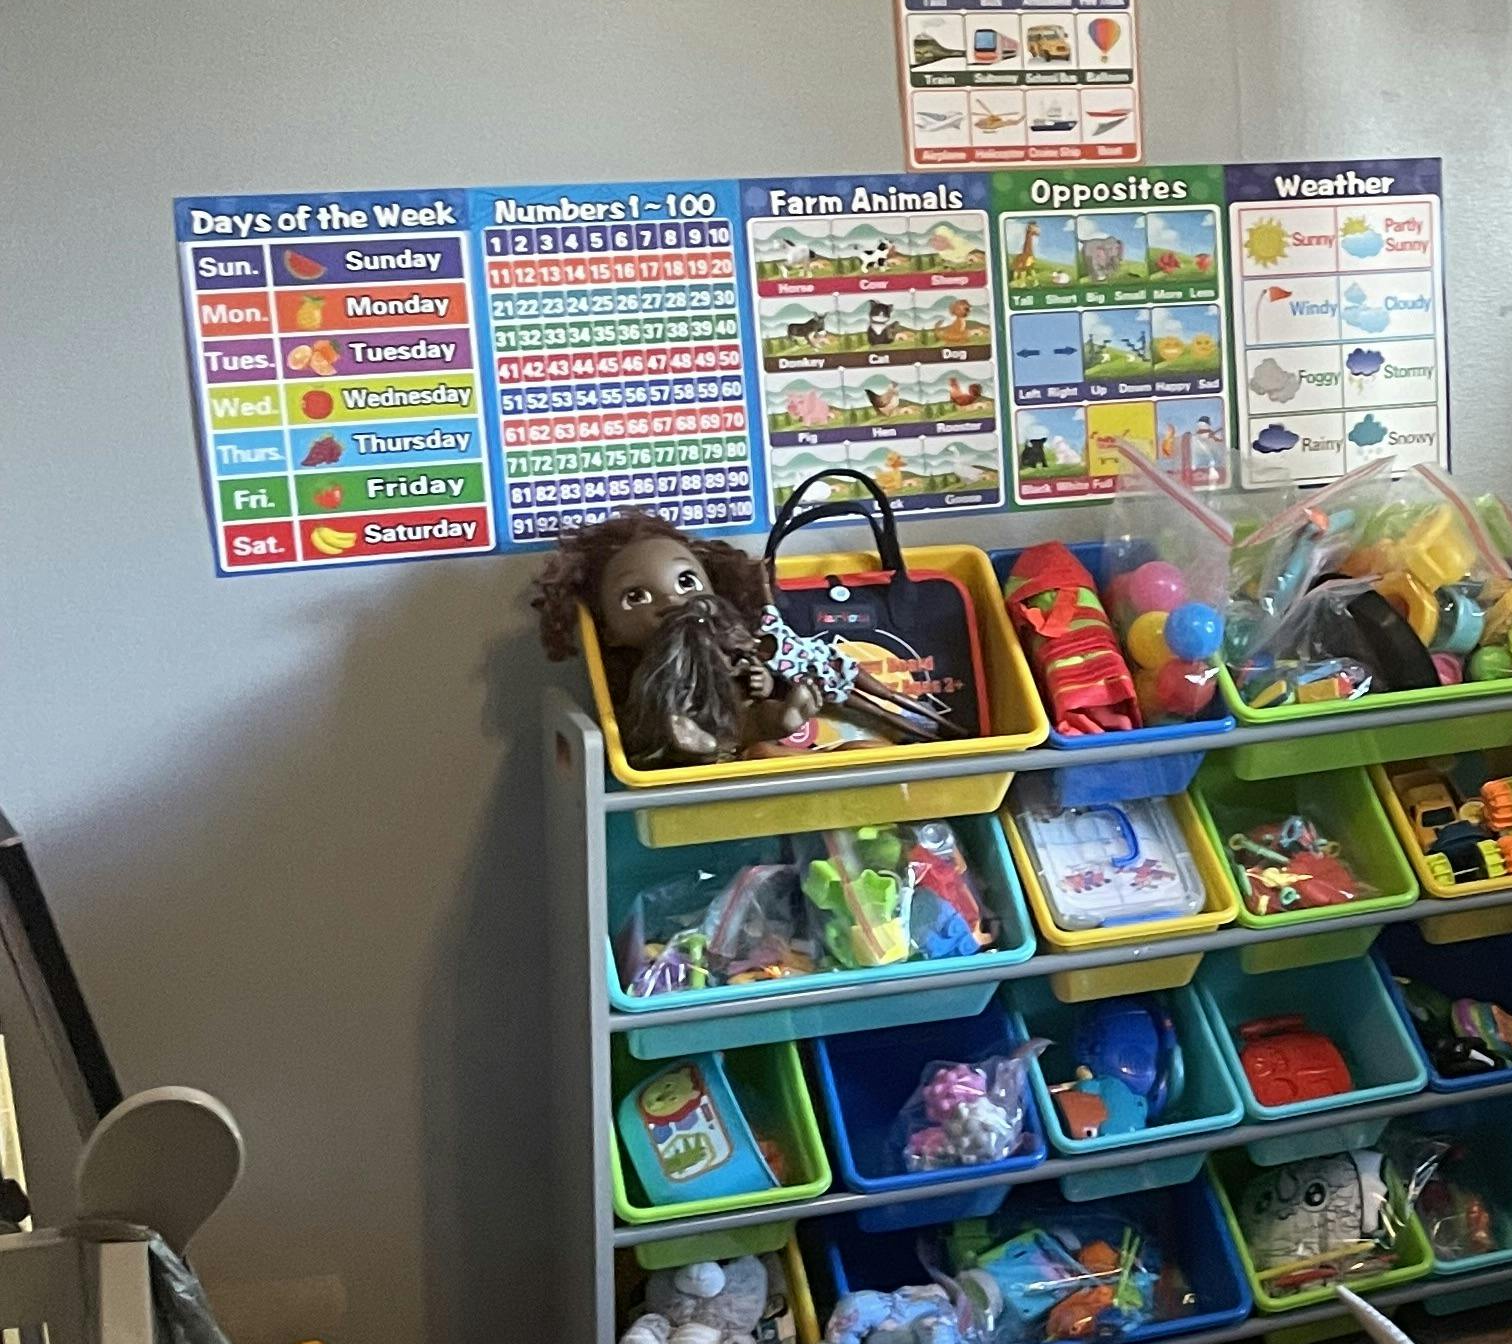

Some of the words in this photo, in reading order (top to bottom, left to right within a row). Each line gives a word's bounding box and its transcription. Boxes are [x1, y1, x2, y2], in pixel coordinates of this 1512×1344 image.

[1031, 176, 1188, 208] Opposites
[1275, 170, 1395, 198] Weather
[494, 197, 626, 224] Numbers
[770, 190, 843, 216] Farm
[851, 184, 964, 213] Animals
[191, 210, 272, 238] Days
[278, 205, 312, 231] of
[317, 203, 368, 230] the
[372, 201, 457, 229] Week
[1385, 217, 1424, 234] Partly
[493, 237, 505, 254] 1
[517, 236, 530, 253] 2
[542, 235, 554, 252] 3
[567, 234, 579, 251] 4
[591, 233, 603, 250] 5
[615, 232, 627, 249] 6
[640, 231, 651, 248] 7
[664, 230, 675, 247] 8
[687, 230, 699, 246] 9
[708, 228, 729, 245] 10
[1292, 232, 1336, 249] Sunny
[1386, 237, 1429, 253] Sunny
[199, 257, 259, 278] Sun.
[345, 249, 442, 272] Sunday
[202, 303, 269, 324] Mon.
[345, 294, 449, 318] Monday
[1290, 300, 1338, 318] Windy
[1384, 295, 1432, 313] Cloudy
[203, 351, 275, 372] Tues.
[348, 339, 455, 363] Tuesday
[1299, 368, 1341, 386] Foggy
[1384, 364, 1434, 379] Stormy
[212, 396, 278, 418] Wed.
[342, 383, 472, 409] Wednesday
[503, 394, 525, 410] 51
[528, 393, 550, 409] 52
[552, 391, 574, 407] 53
[577, 390, 598, 406] 54
[601, 389, 622, 404] 55
[625, 387, 646, 403] 56
[649, 386, 670, 402] 57
[673, 384, 694, 400] 58
[696, 383, 717, 399] 59
[720, 382, 741, 397] 60
[353, 429, 470, 454] Thursday
[1302, 437, 1343, 453] Rainy
[1388, 430, 1435, 447] Snowy
[509, 456, 531, 472] 71
[533, 454, 555, 470] 72
[558, 452, 579, 468] 73
[582, 451, 603, 467] 74
[606, 449, 627, 465] 75
[630, 448, 651, 464] 76
[654, 446, 675, 462] 77
[677, 445, 698, 460] 78
[701, 443, 722, 459] 79
[724, 442, 745, 457] 80
[366, 476, 465, 499] Friday
[511, 486, 533, 502] 81
[233, 489, 275, 511] Fri.
[364, 518, 477, 543] Saturday
[233, 536, 286, 556] Sat.
